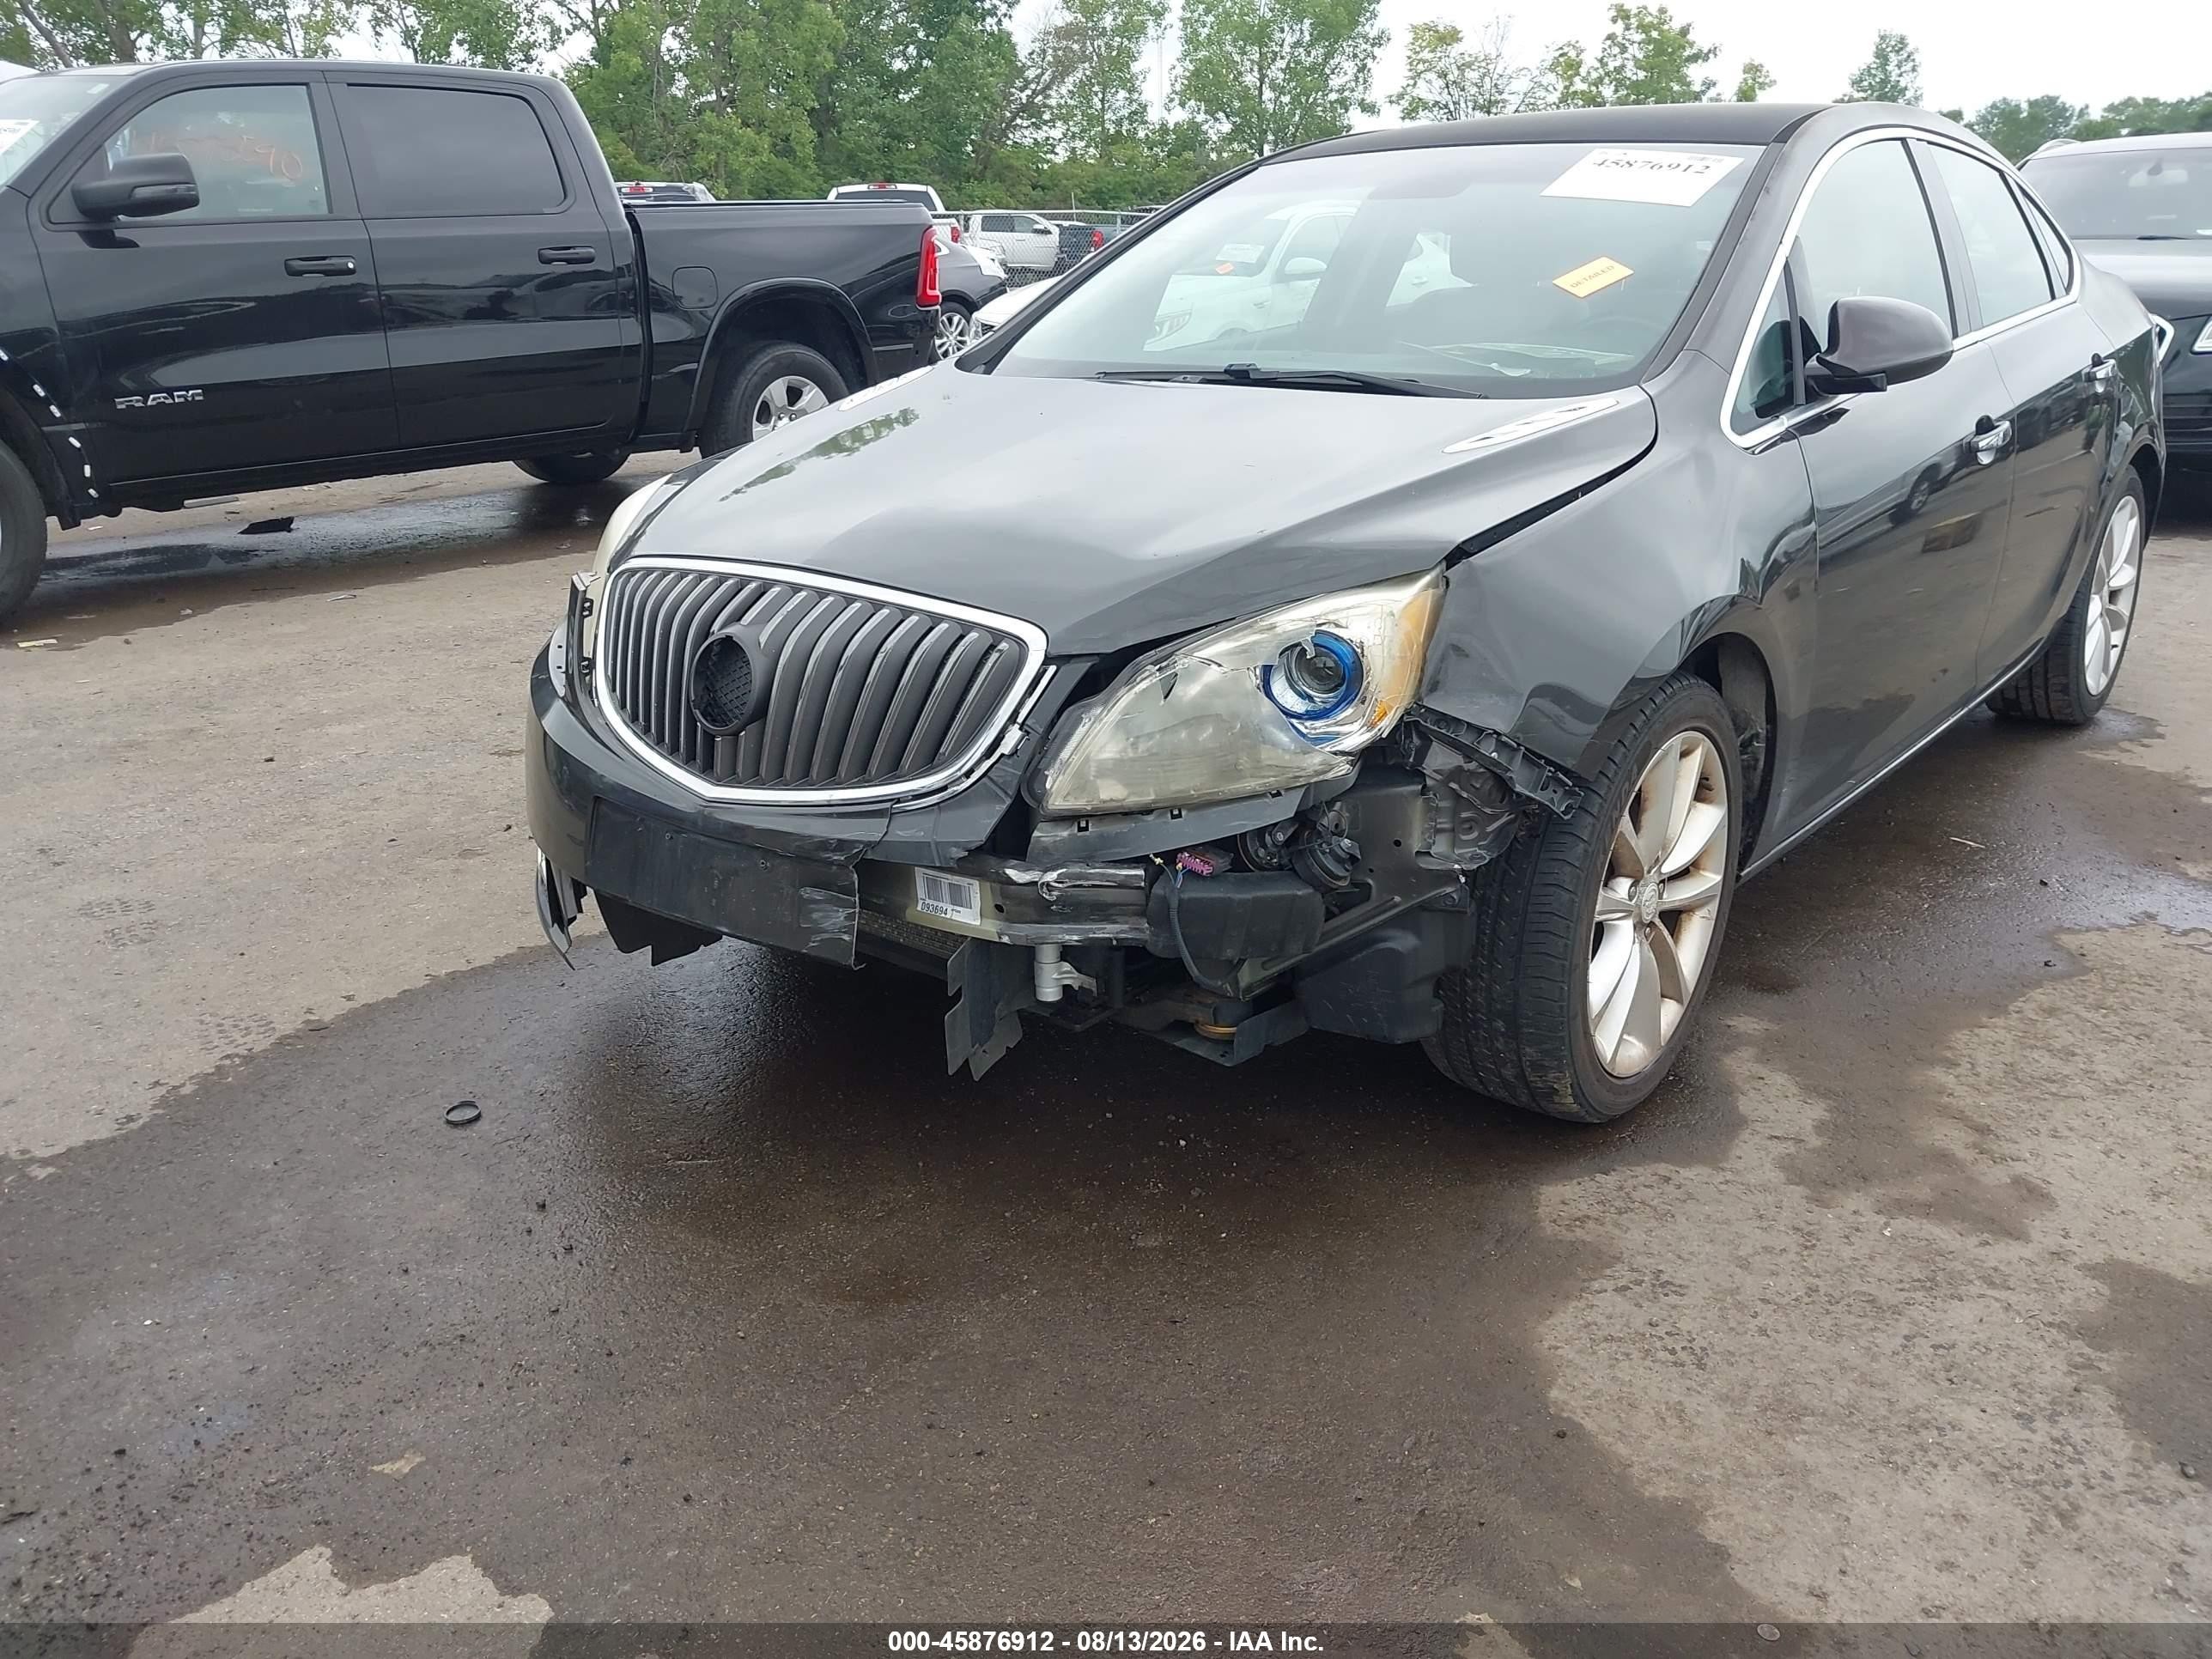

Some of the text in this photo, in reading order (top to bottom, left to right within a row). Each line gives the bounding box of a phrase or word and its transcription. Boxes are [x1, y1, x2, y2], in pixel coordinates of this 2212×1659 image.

[1594, 158, 1711, 174] 45876912
[1570, 265, 1615, 288] DETAILED
[114, 389, 204, 409] RAM
[921, 902, 948, 916] 093694
